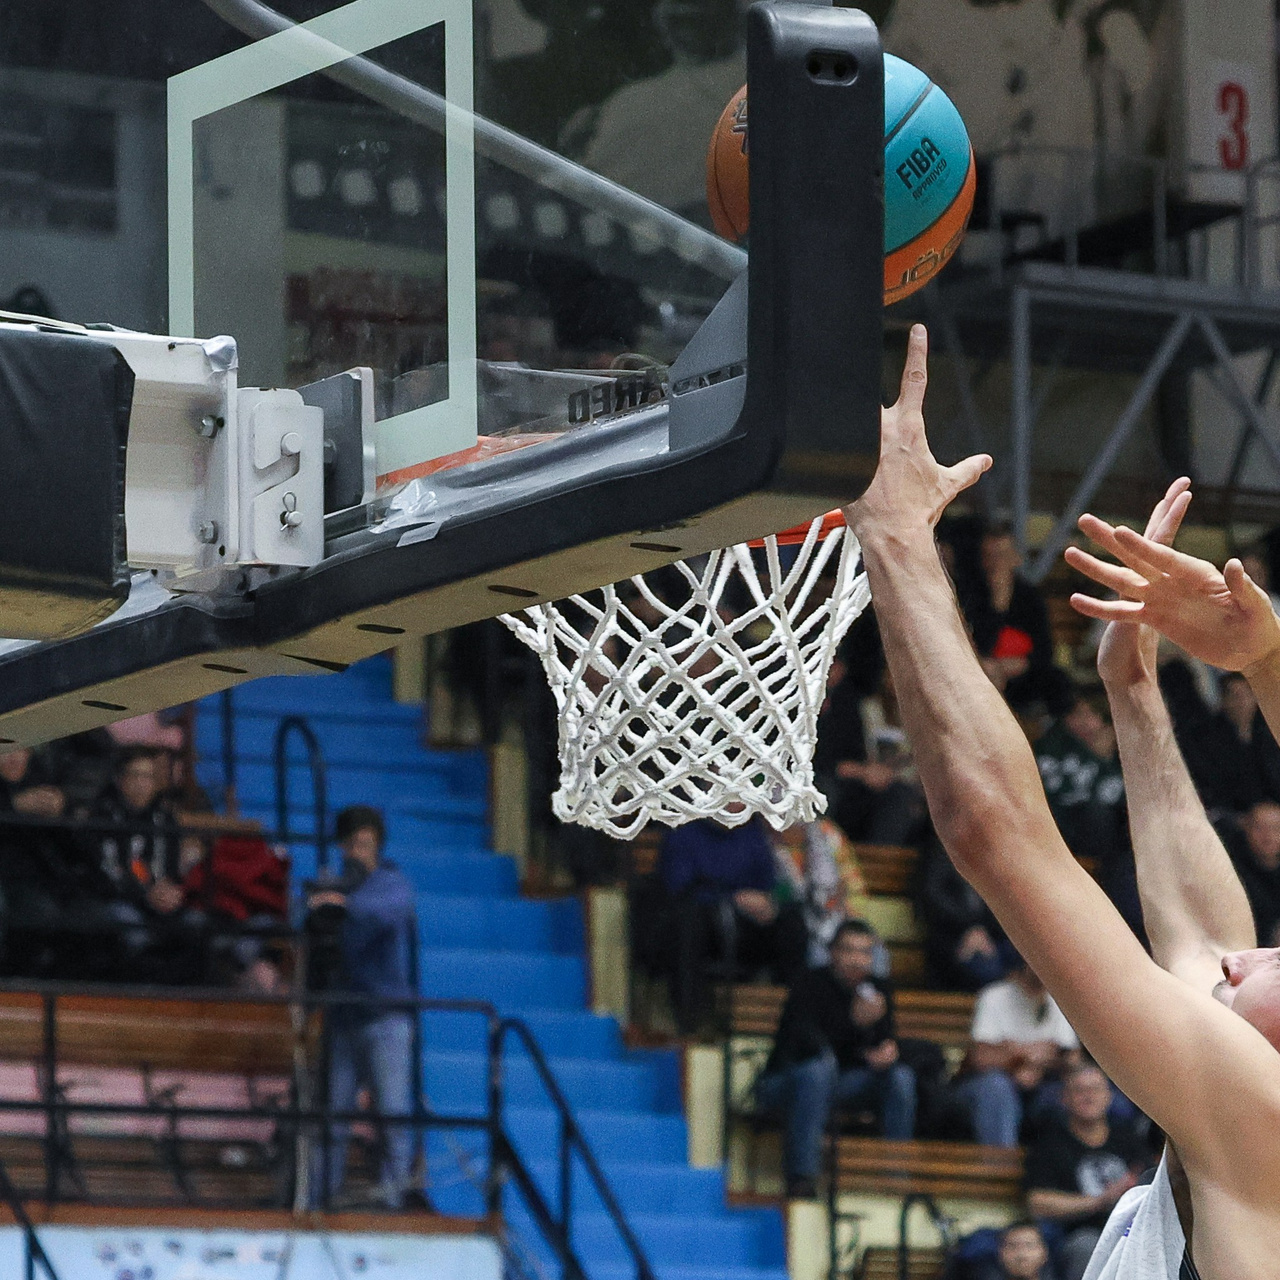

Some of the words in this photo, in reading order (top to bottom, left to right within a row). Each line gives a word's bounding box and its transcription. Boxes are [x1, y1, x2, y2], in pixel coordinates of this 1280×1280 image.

[1216, 81, 1249, 170] 3
[896, 137, 941, 189] FIBA
[912, 158, 948, 200] APPROVED
